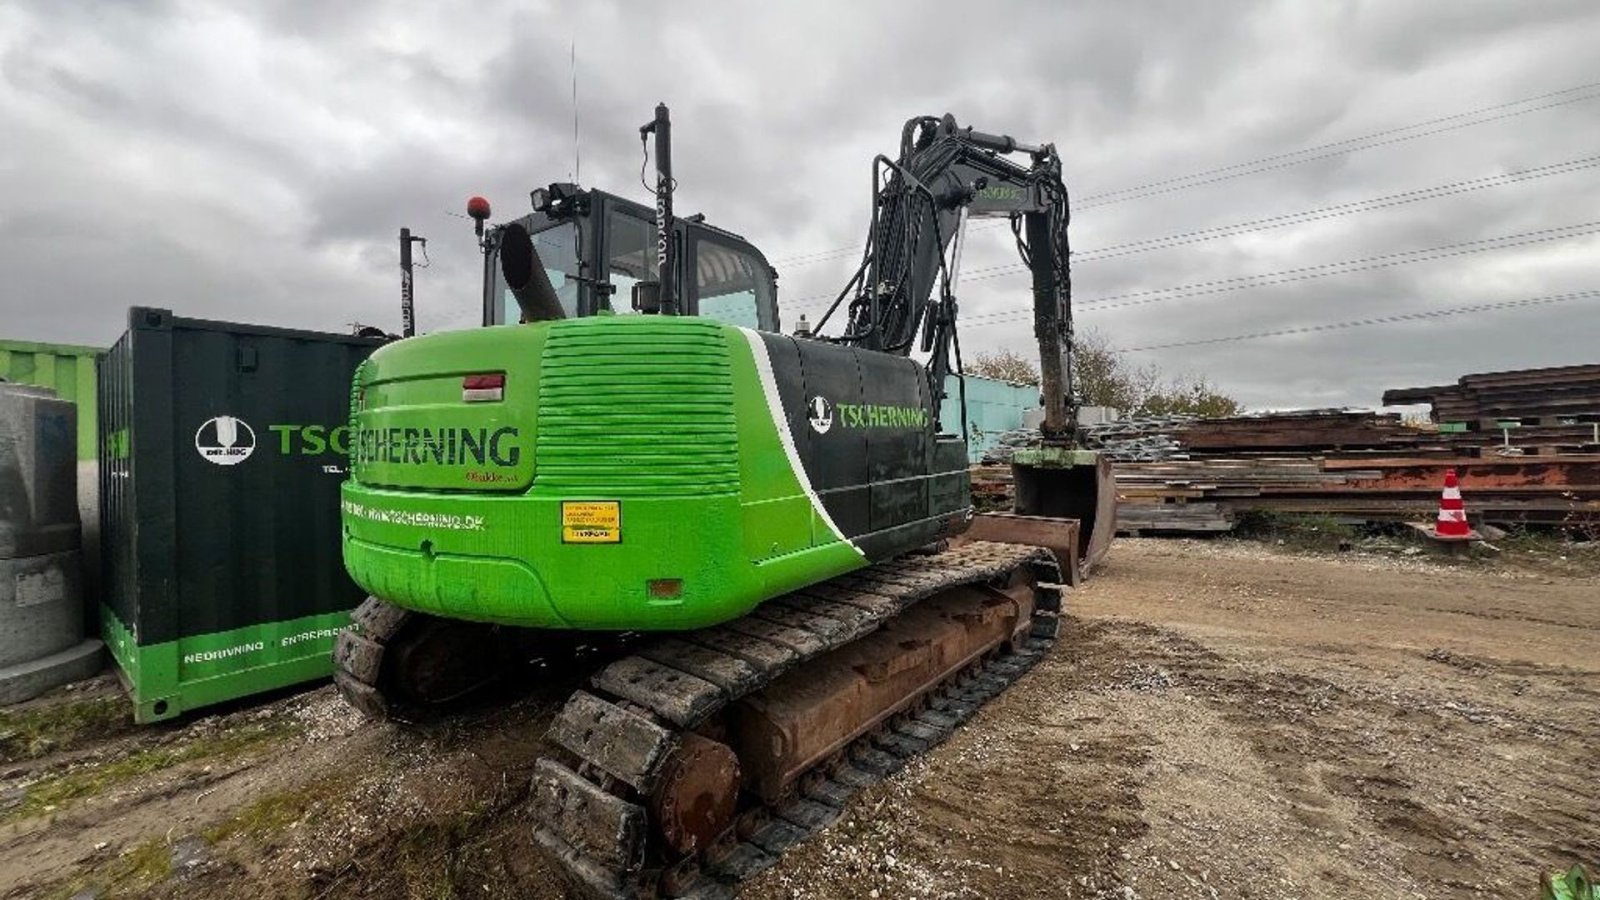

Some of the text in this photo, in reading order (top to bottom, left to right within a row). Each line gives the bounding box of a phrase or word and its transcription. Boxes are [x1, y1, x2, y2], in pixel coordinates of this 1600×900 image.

[836, 403, 928, 428] TSCHERNING
[269, 425, 350, 454] TSC
[359, 426, 519, 467] SCHERNING
[184, 641, 264, 664] NEDRIVNING
